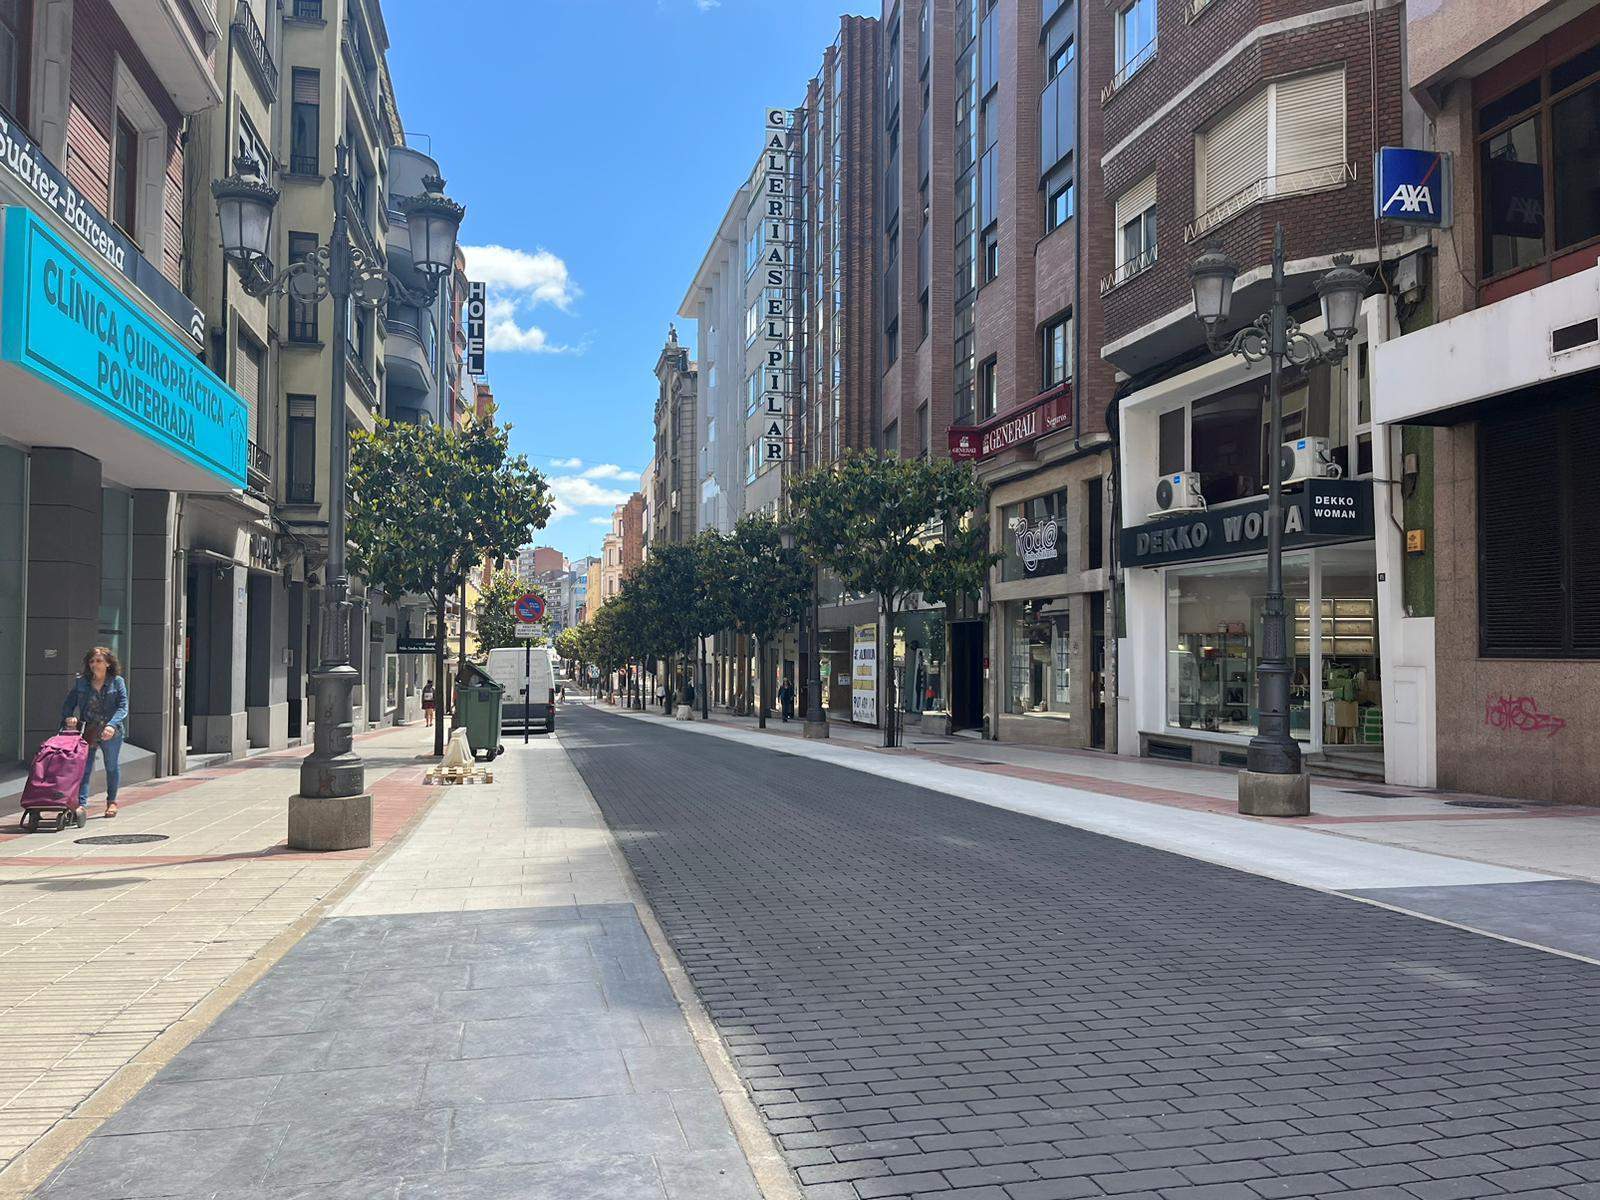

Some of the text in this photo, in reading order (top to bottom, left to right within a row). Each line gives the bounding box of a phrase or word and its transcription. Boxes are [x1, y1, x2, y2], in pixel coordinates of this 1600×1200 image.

[1382, 184, 1434, 214] AXA
[767, 110, 784, 459] GALERIAS EL PILAR
[43, 258, 225, 428] CLÍNICA QUIROPRÁCTICA
[468, 282, 484, 373] HOTEL
[97, 350, 197, 446] PONFERRADA
[988, 411, 1037, 451] GENERALI
[1046, 413, 1067, 428] Seguros
[1314, 508, 1356, 519] WOMAN
[1315, 496, 1354, 506] DEKKO
[1136, 522, 1210, 556] DEKKO
